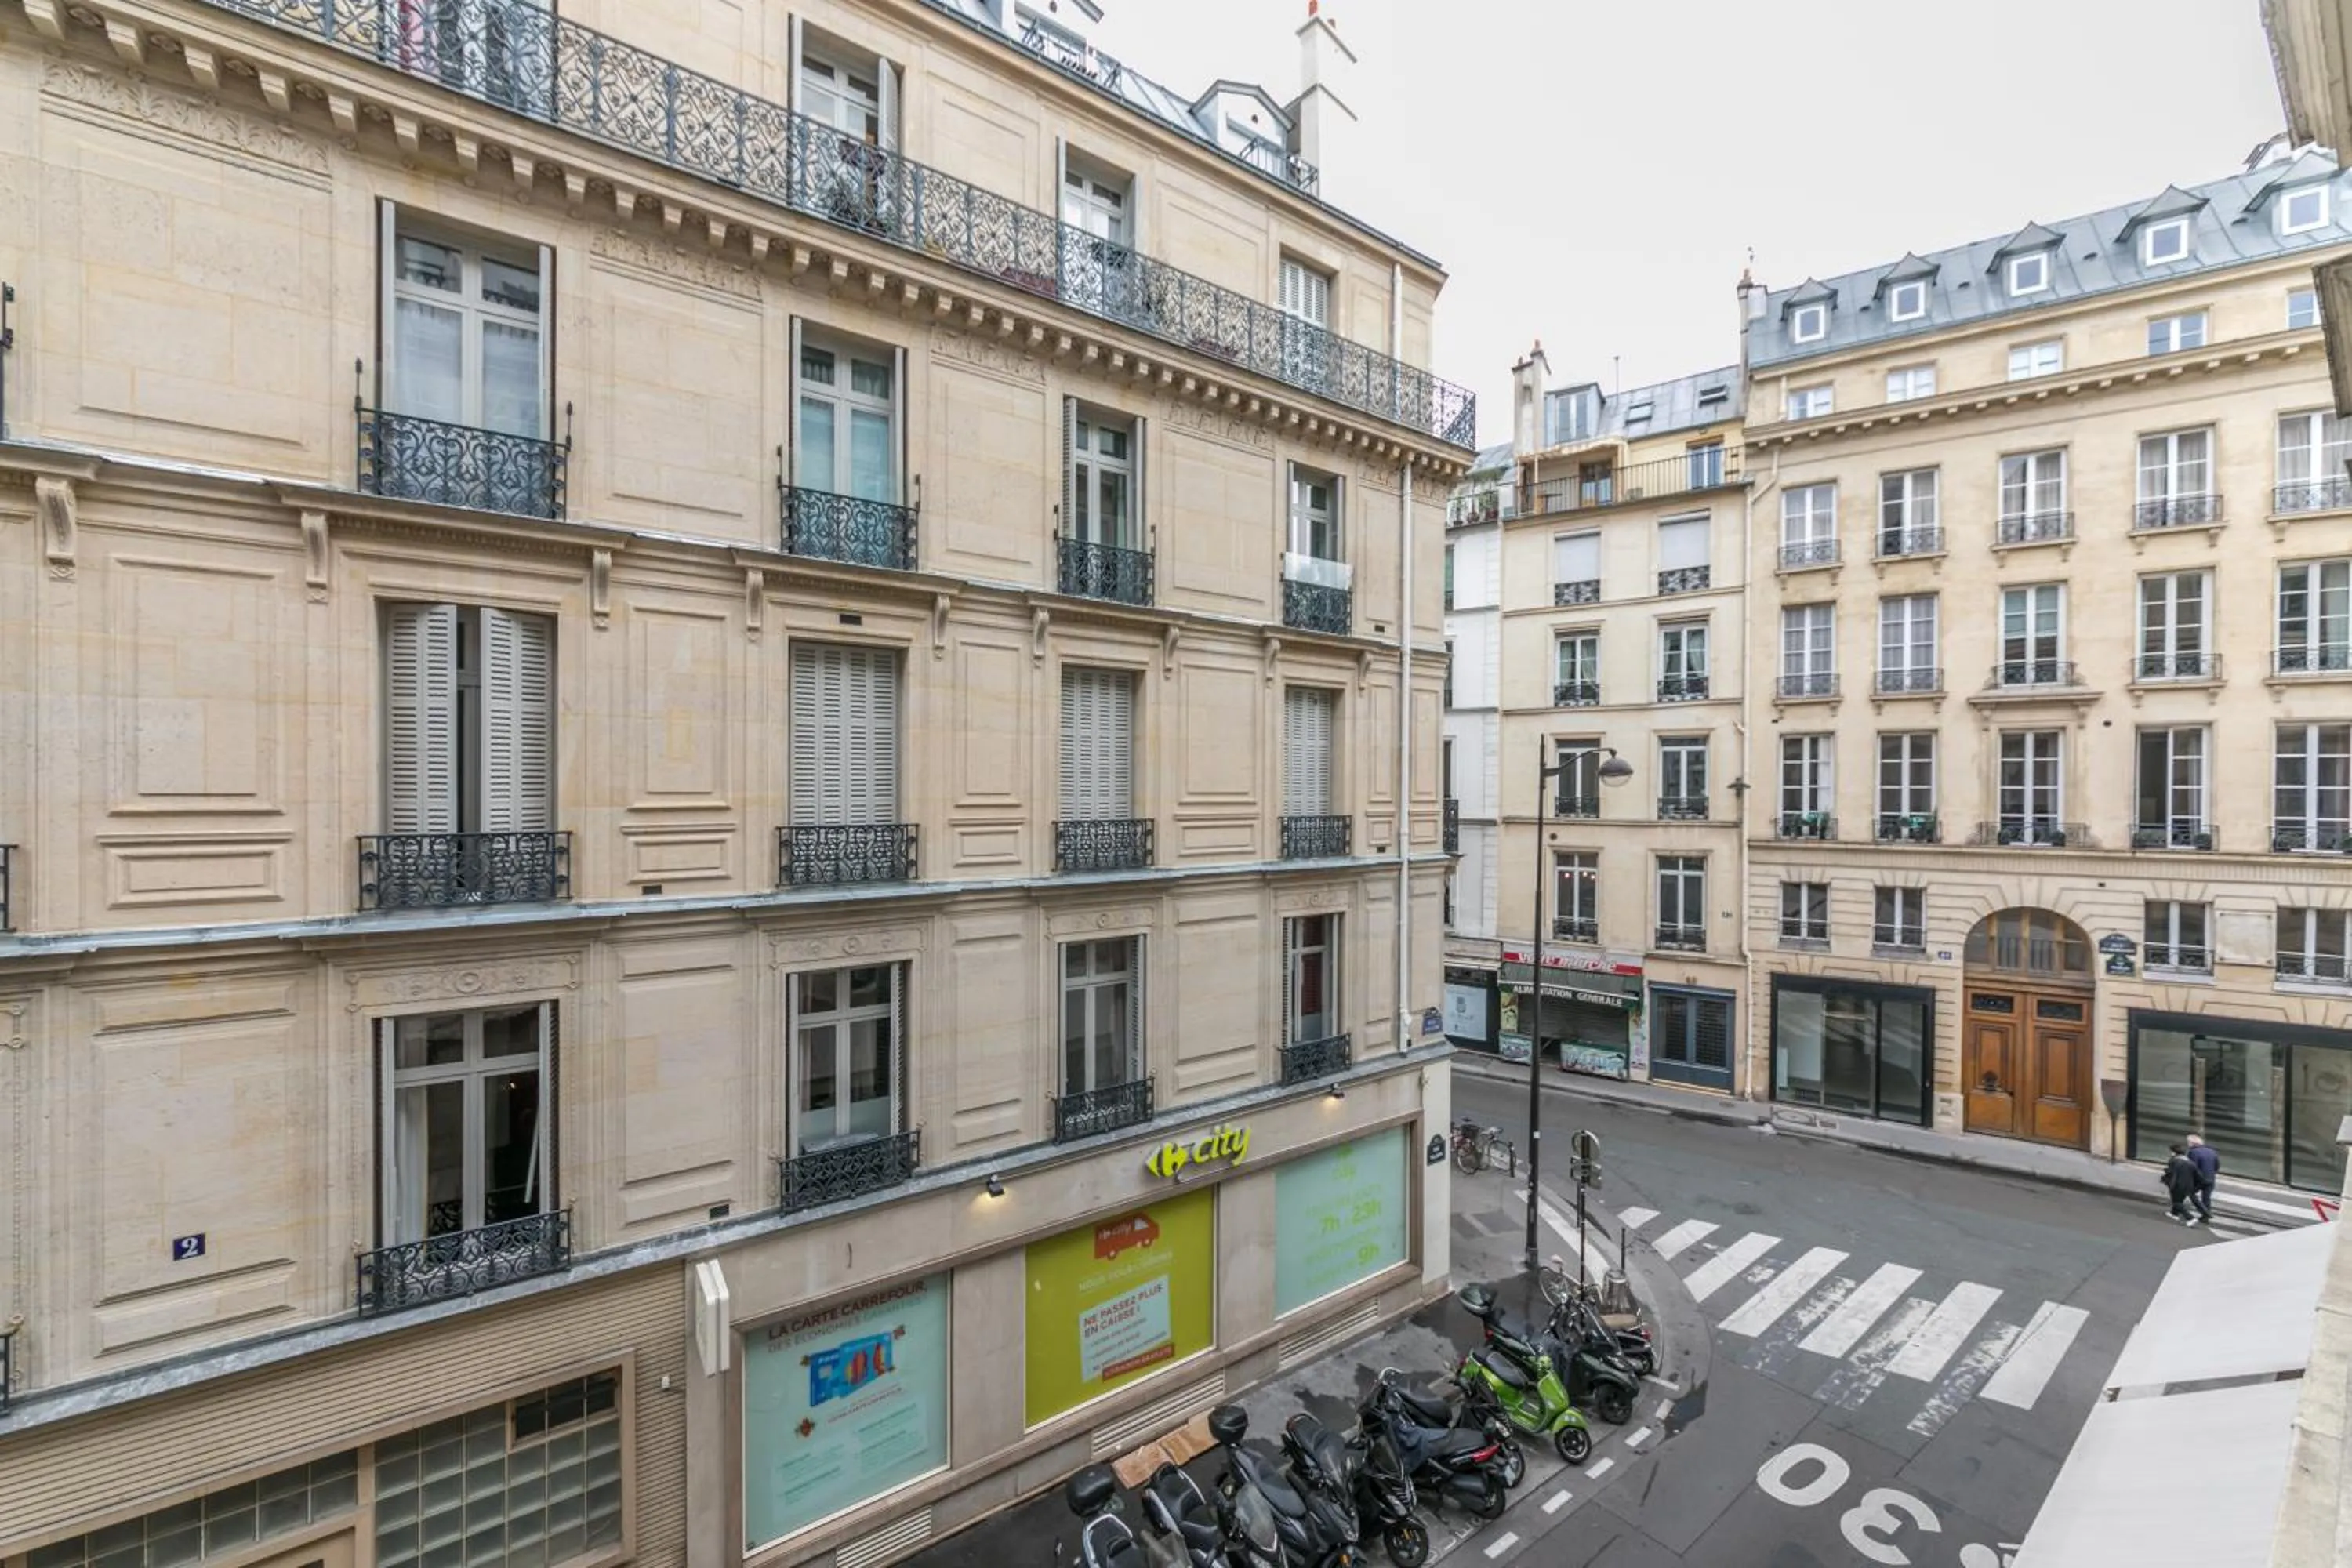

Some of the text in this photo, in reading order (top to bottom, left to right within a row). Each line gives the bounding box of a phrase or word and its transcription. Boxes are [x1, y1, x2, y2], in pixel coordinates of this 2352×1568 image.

[1513, 985, 1572, 1000] ALIMNTATION
[1192, 1123, 1252, 1166] city
[180, 1237, 199, 1258] 2
[1083, 1283, 1163, 1327] NE PASSEZ PLUS
[1084, 1323, 1098, 1338] EN
[1099, 1305, 1135, 1330] CAISSE
[768, 1323, 789, 1341] LA
[791, 1308, 839, 1332] CARTE
[1757, 1443, 1942, 1566] 30
